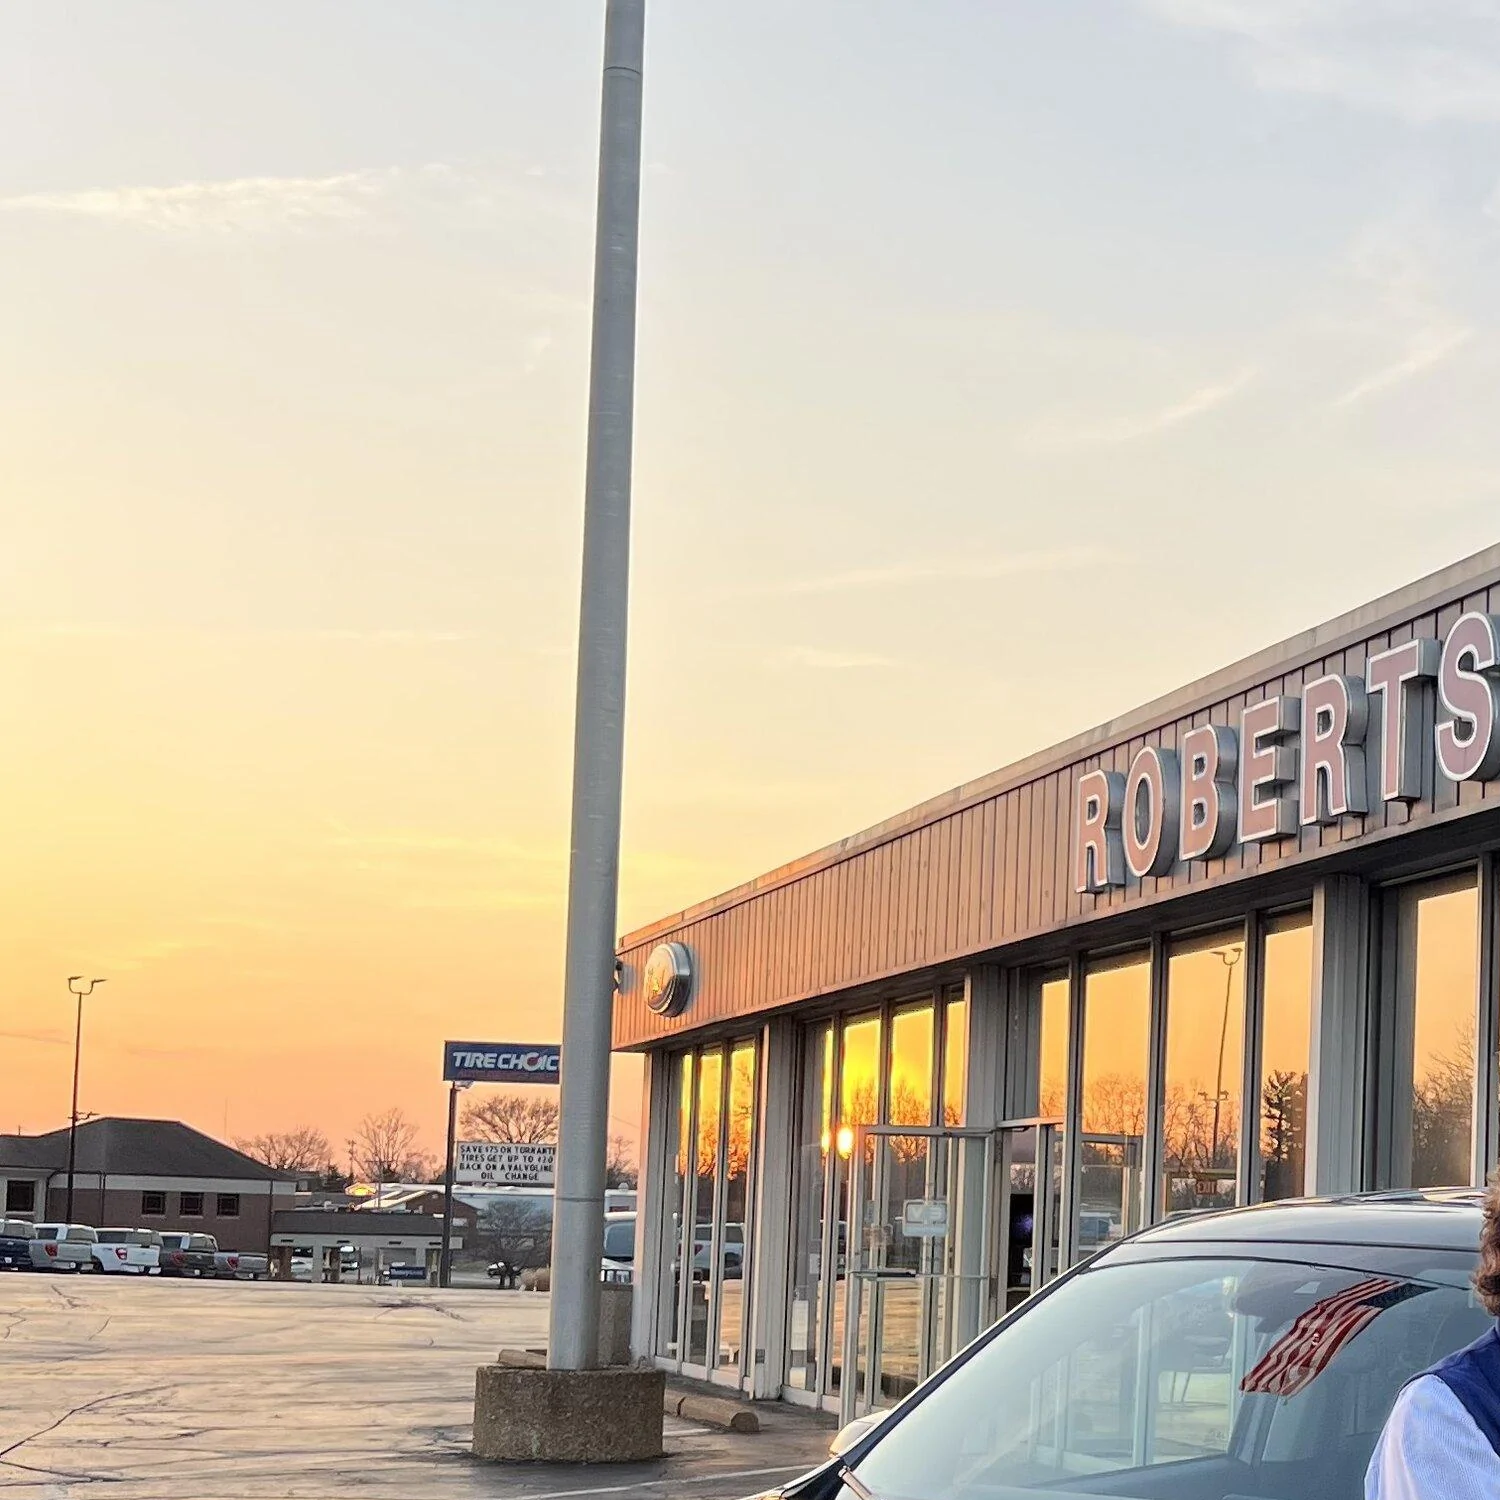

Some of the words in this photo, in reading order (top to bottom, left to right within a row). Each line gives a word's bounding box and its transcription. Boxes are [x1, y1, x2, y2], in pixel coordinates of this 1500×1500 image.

[498, 1052, 560, 1071] CHOIC
[460, 1145, 483, 1153] SAVE
[485, 1146, 498, 1154] $75
[500, 1146, 511, 1154] ON
[461, 1154, 485, 1162] TIRES
[487, 1154, 503, 1162] GET
[508, 1155, 519, 1163] UP
[523, 1155, 534, 1163] TO
[459, 1163, 481, 1171] BACK
[486, 1163, 496, 1171] ON
[508, 1164, 553, 1172] VALVOLINE
[481, 1172, 494, 1180] OIL
[505, 1172, 538, 1180] CHANGE
